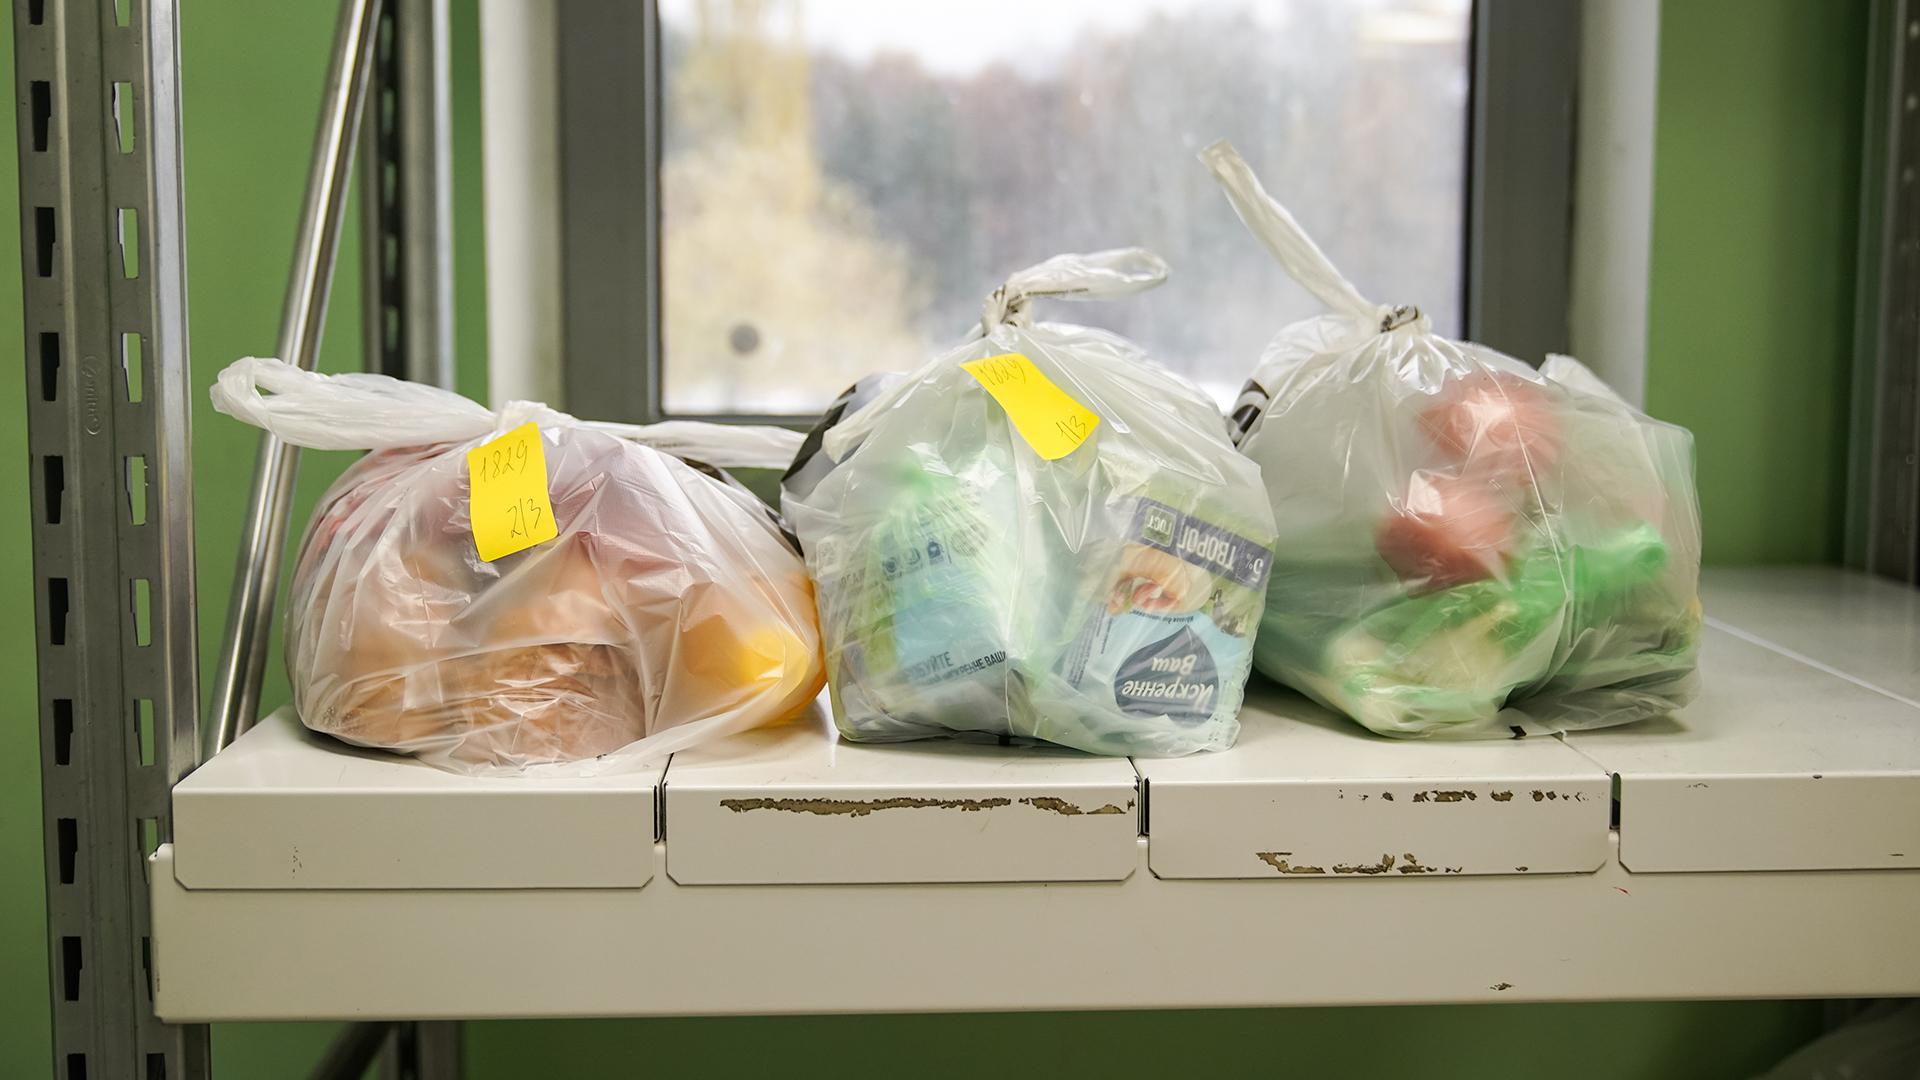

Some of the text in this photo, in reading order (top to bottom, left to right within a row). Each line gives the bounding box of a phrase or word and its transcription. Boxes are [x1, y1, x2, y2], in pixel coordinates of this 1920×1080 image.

[480, 439, 528, 483] 1829
[506, 498, 542, 539] 2/3
[1145, 514, 1173, 537] ГОСТ
[1176, 525, 1237, 571] ТВОРОГ
[1151, 654, 1197, 676] Ваш
[1121, 676, 1215, 714] Искренне
